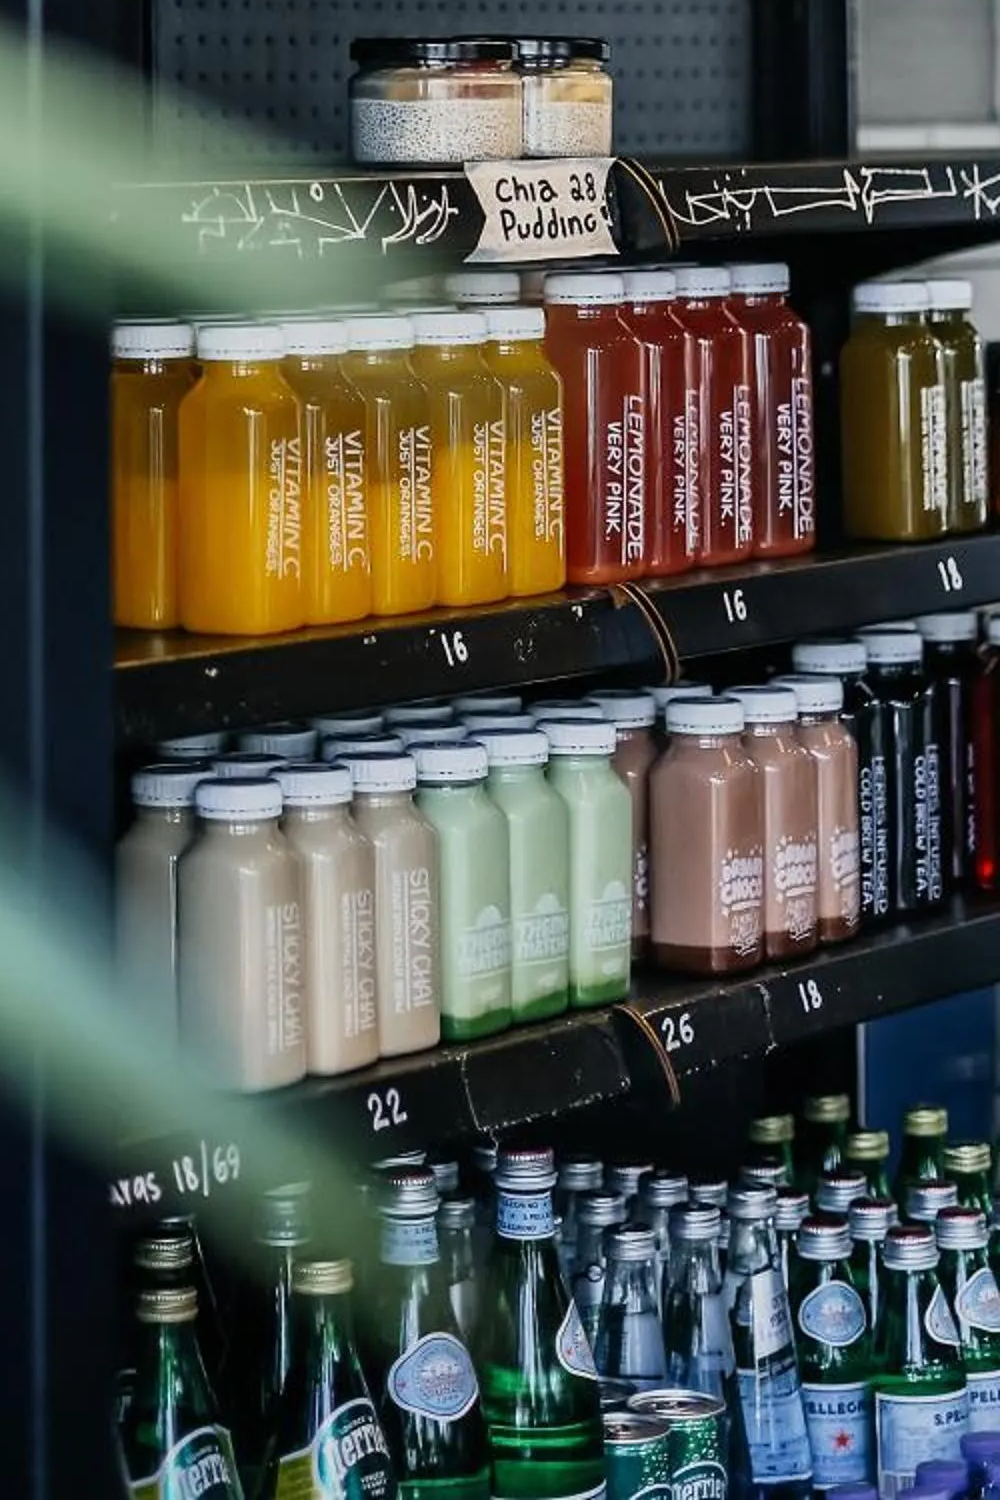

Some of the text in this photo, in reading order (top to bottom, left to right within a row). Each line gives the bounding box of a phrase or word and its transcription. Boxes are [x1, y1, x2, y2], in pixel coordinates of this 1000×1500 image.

[495, 171, 597, 202] Chia 28
[673, 414, 686, 469] VERY
[719, 410, 733, 464] VERY
[776, 402, 792, 456] VERY
[605, 421, 623, 541] VERY PINK.
[347, 546, 366, 569] C
[416, 539, 434, 562] C
[489, 532, 506, 555] C
[937, 556, 963, 593] 18
[722, 589, 748, 624] 16
[439, 630, 469, 668] 16
[409, 867, 434, 1009] STICKY CHAI
[799, 979, 823, 1013] 18
[661, 1013, 694, 1052] 26
[367, 1087, 408, 1132] 22
